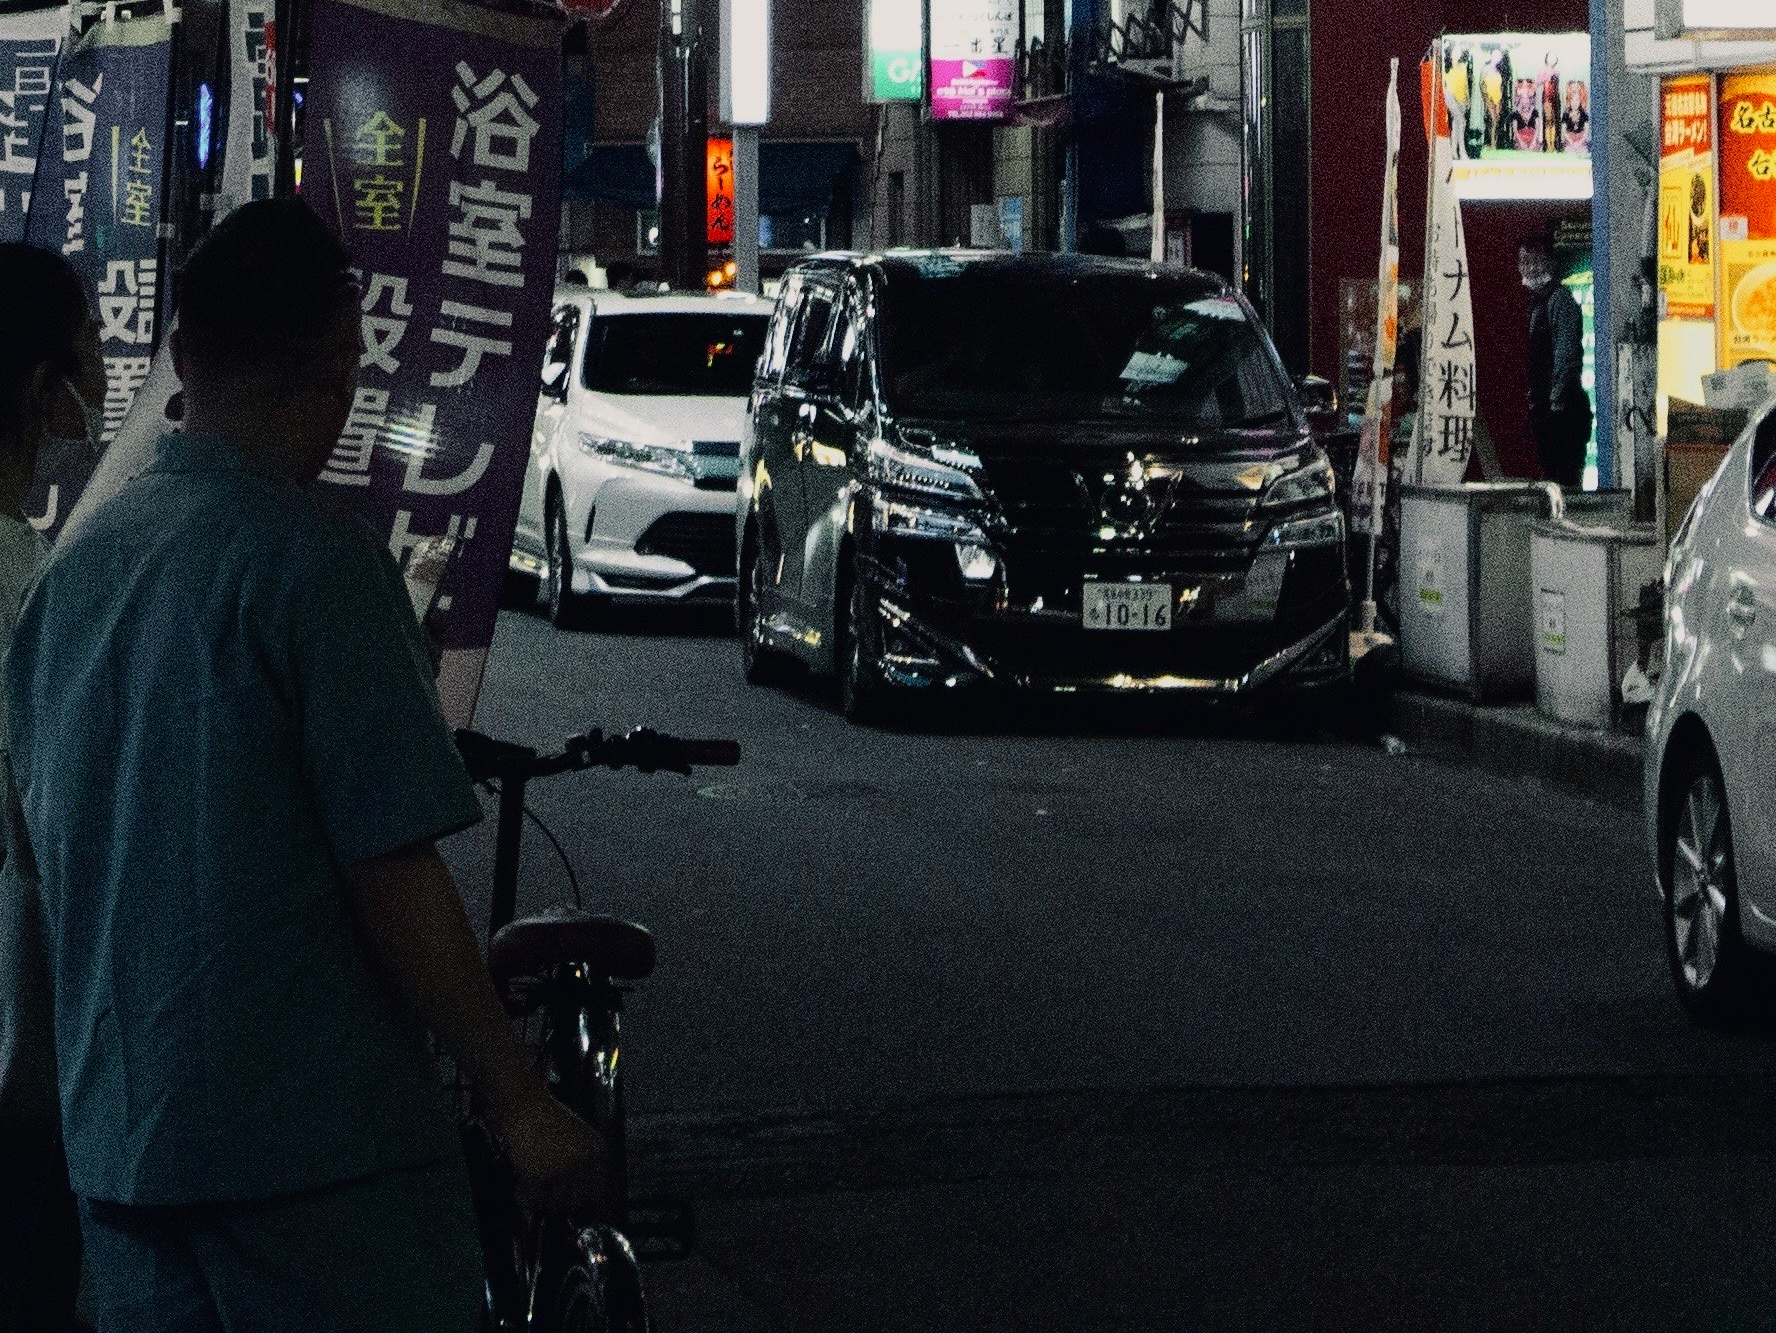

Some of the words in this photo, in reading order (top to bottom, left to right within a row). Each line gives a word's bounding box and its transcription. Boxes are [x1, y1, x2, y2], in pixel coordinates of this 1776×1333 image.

[356, 110, 406, 232] 全室
[711, 156, 731, 231] らーめん
[1106, 603, 1167, 626] 10-16
